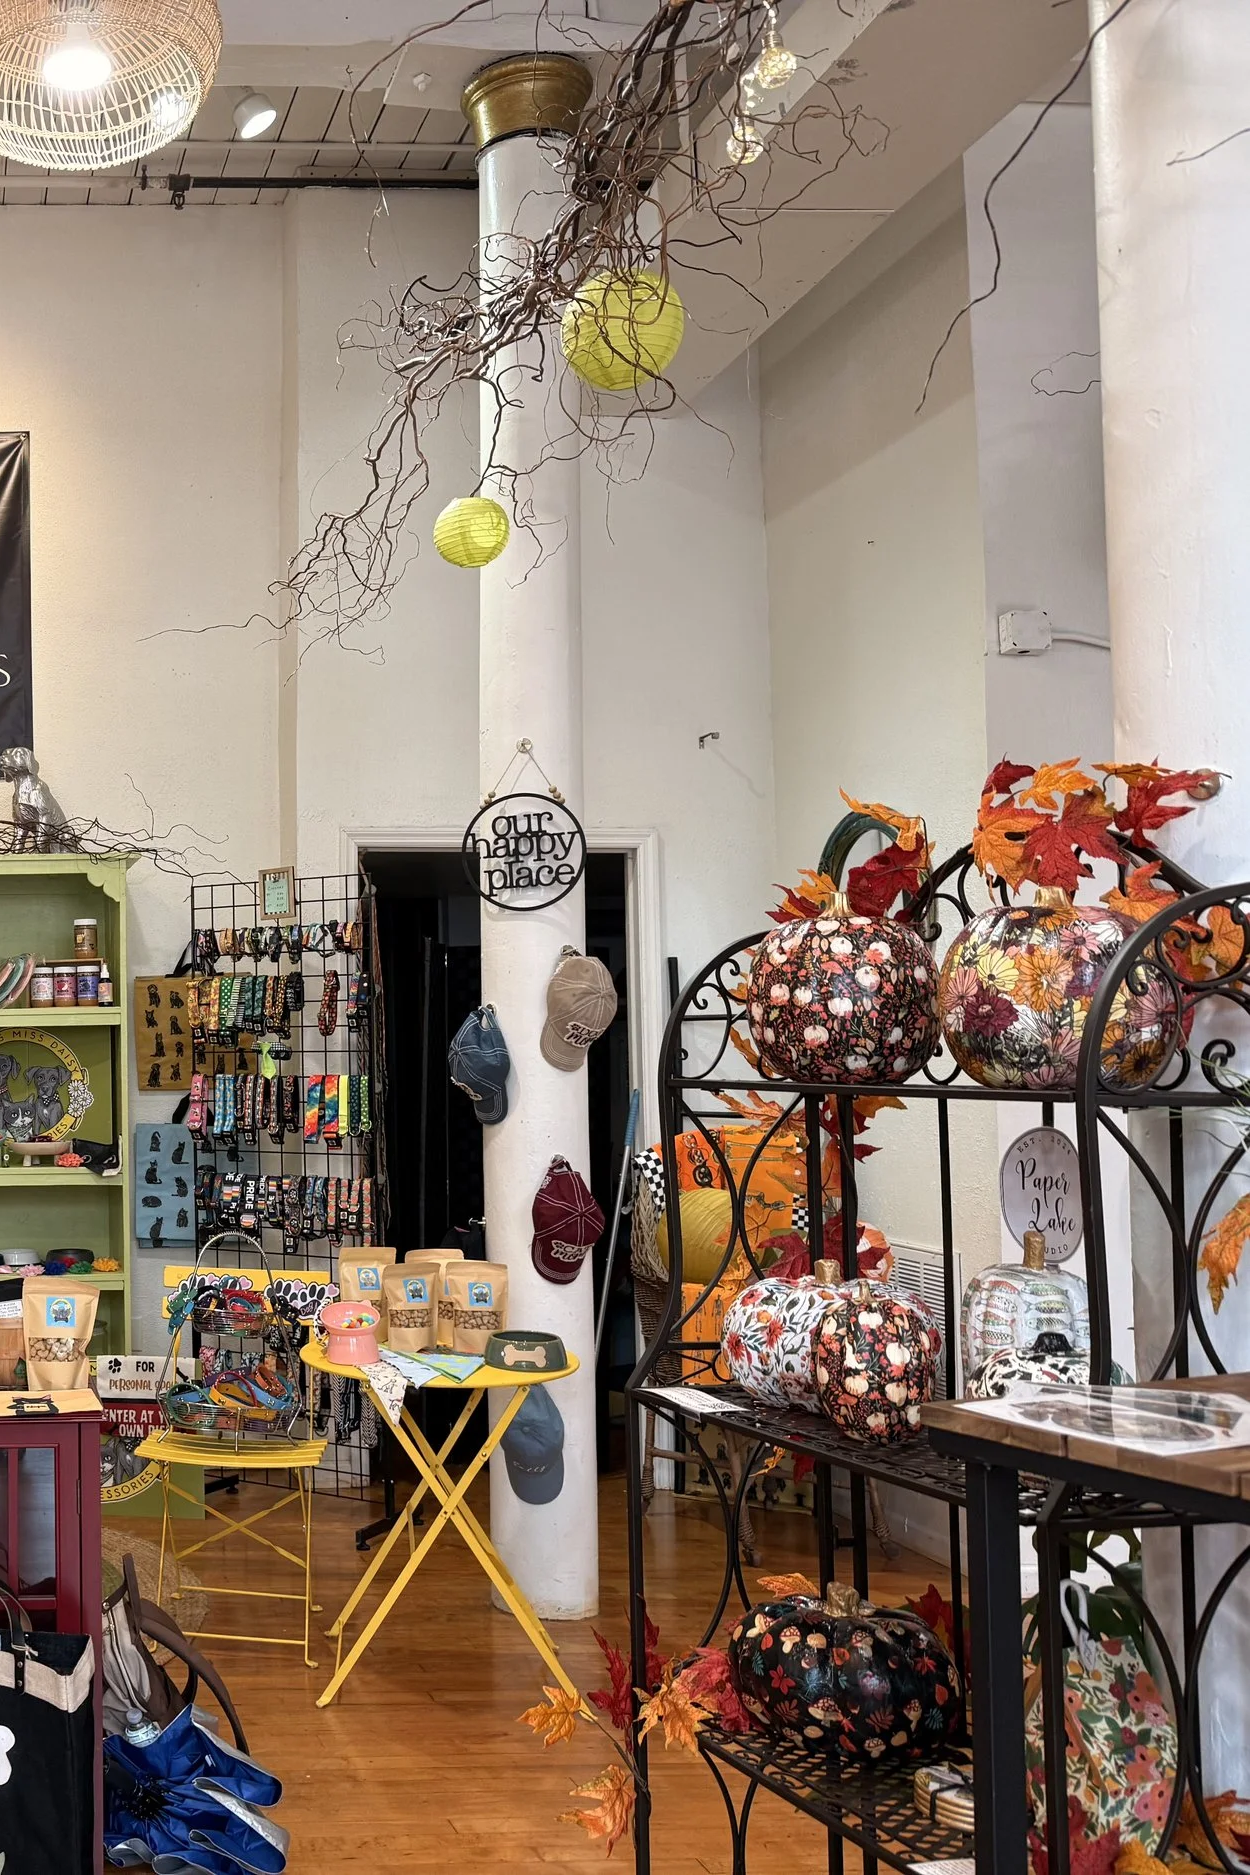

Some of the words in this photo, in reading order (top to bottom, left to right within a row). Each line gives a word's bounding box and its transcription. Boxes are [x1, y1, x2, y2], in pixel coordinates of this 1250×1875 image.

[492, 811, 553, 837] our
[469, 831, 580, 862] happy
[484, 860, 576, 897] place
[12, 1030, 45, 1040] MISS
[50, 1041, 81, 1074] DAISY
[1017, 1137, 1041, 1153] EST.
[245, 1180, 256, 1210] PRIDE
[1015, 1158, 1071, 1209] Paper
[1028, 1197, 1077, 1236] Lake
[1044, 1244, 1069, 1255] UDIO
[136, 1361, 155, 1372] FOR
[109, 1378, 152, 1391] PERSONAL
[155, 1380, 174, 1391] SPA
[140, 1410, 154, 1423] AT
[119, 1424, 144, 1438] OWN
